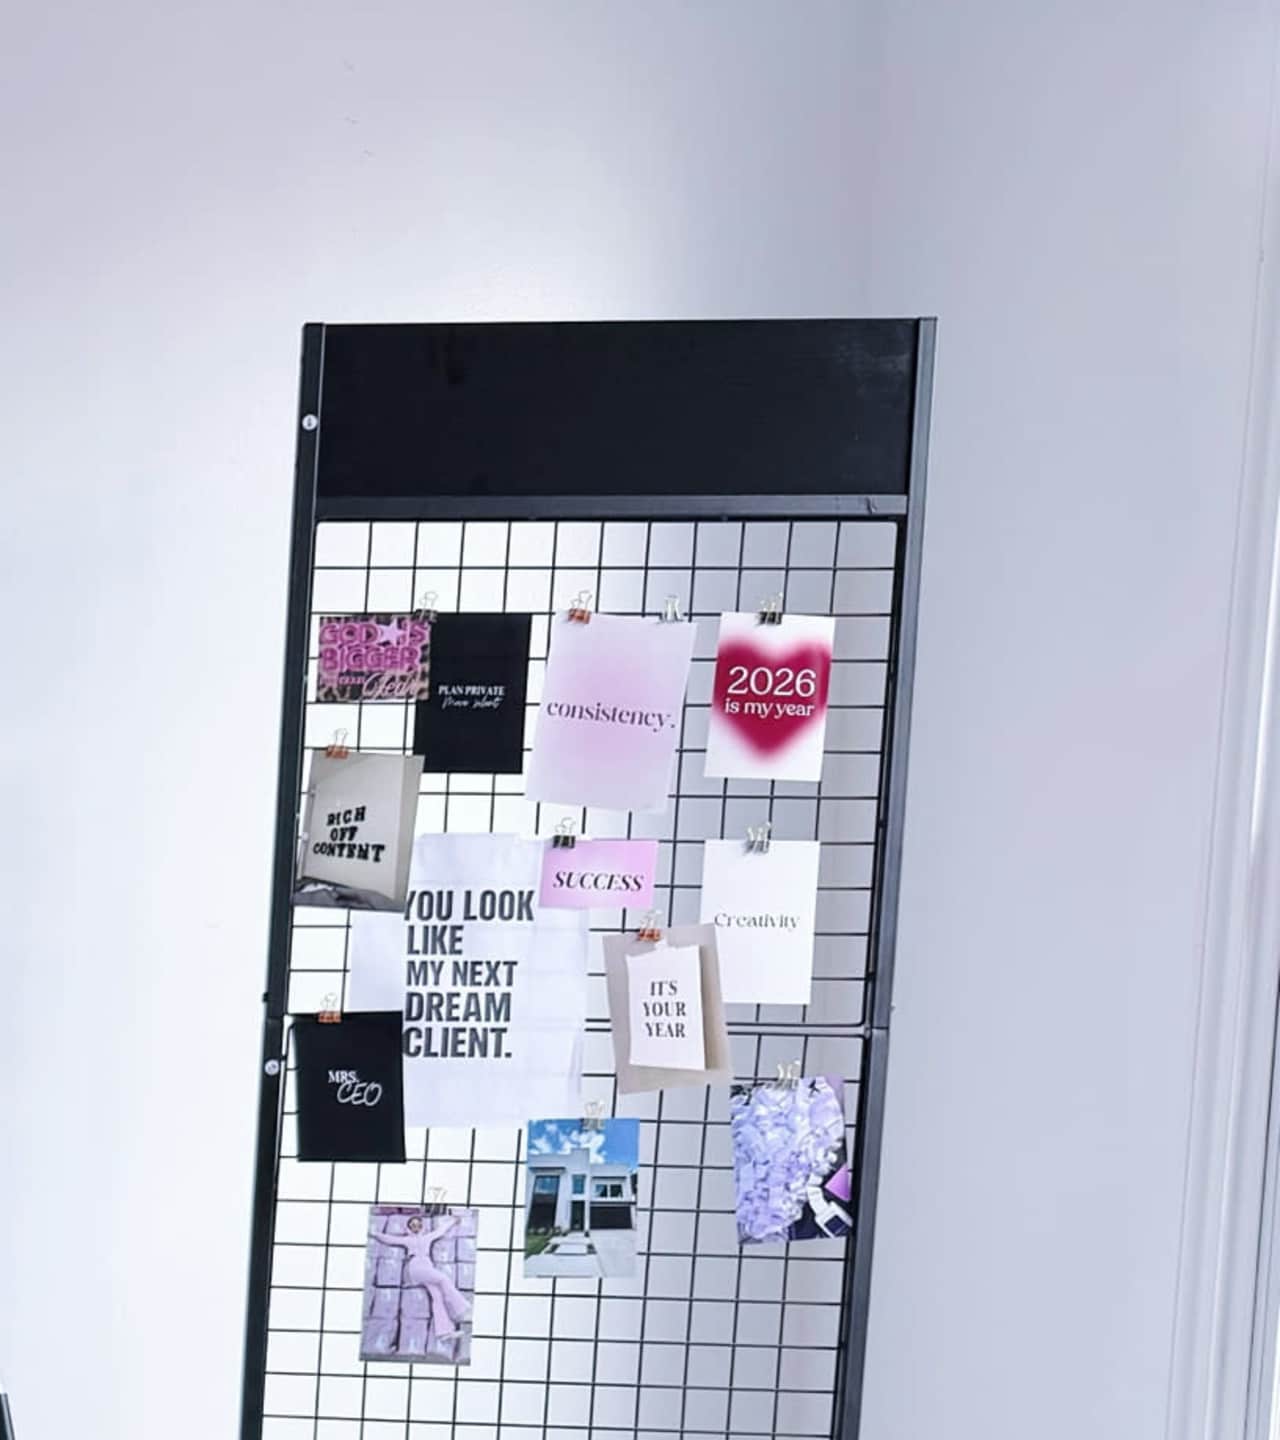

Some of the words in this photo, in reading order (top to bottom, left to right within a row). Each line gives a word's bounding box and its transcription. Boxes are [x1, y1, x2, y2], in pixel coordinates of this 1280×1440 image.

[321, 624, 378, 645] GOD
[323, 648, 418, 672] BIGGER
[439, 685, 464, 696] PLAN
[465, 685, 505, 696] PRIVATE
[728, 666, 816, 697] 2026
[546, 702, 676, 732] consistency.
[724, 698, 739, 714] is
[745, 702, 771, 719] my
[774, 702, 815, 718] year
[327, 805, 366, 826] RICH
[313, 841, 385, 862] CONTENT
[553, 871, 644, 891] SUCCESS
[463, 890, 535, 921] LOOK
[714, 912, 800, 931] Creativity
[407, 925, 463, 955] LIKE
[406, 961, 444, 987] MY
[452, 961, 518, 987] NEXT
[405, 993, 511, 1022] DREAM
[643, 1002, 686, 1017] YOUR
[645, 1022, 686, 1038] YEAR
[403, 1028, 512, 1058] CLIENT.
[337, 1082, 382, 1106] CEO
